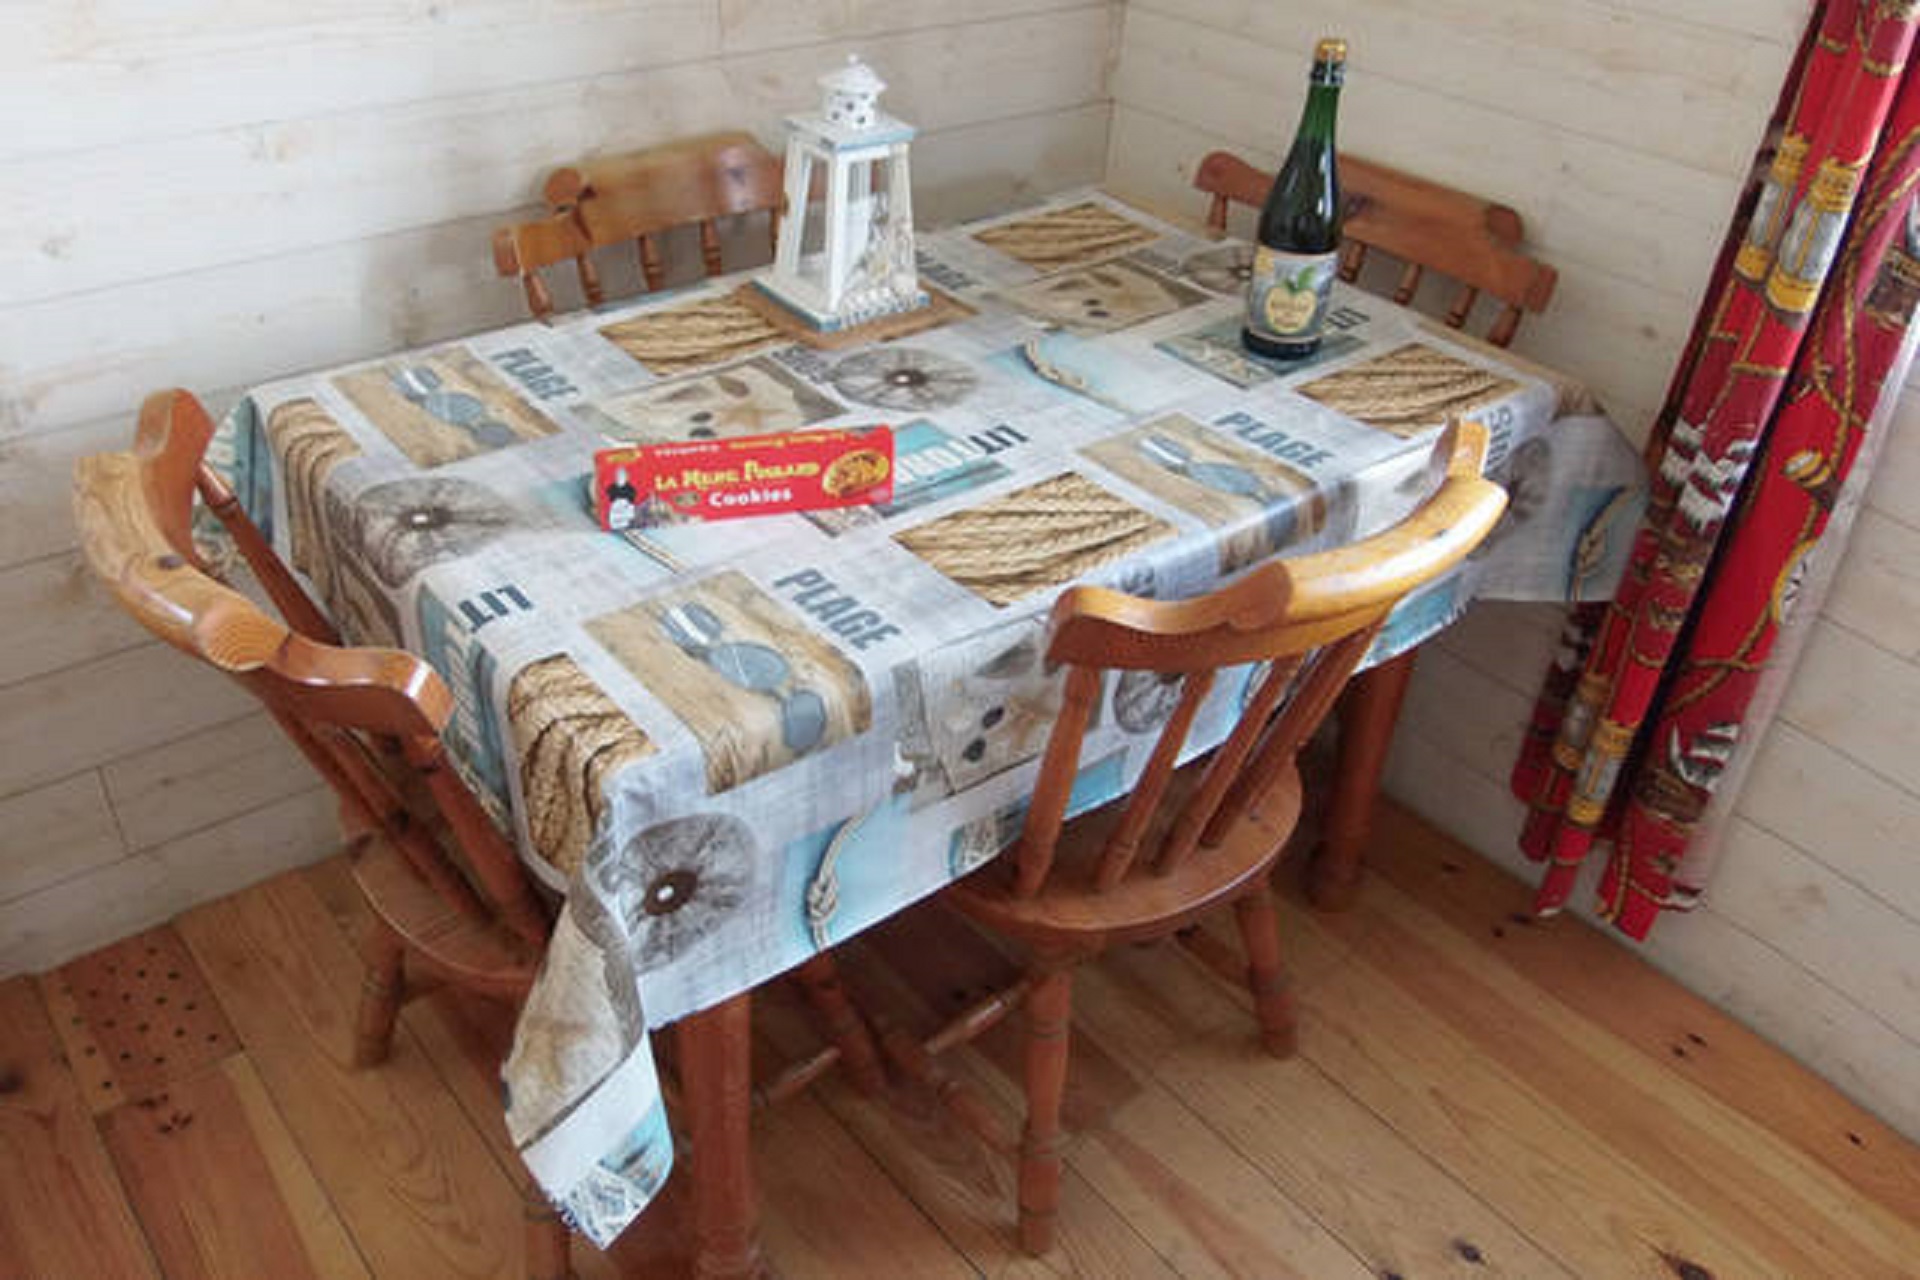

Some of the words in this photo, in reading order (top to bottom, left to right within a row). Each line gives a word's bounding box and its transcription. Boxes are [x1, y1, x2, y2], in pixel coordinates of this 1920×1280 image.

[1212, 411, 1335, 467] PLAGE
[655, 475, 678, 491] LA
[709, 488, 793, 508] Cookies
[773, 568, 901, 651] PLAGE
